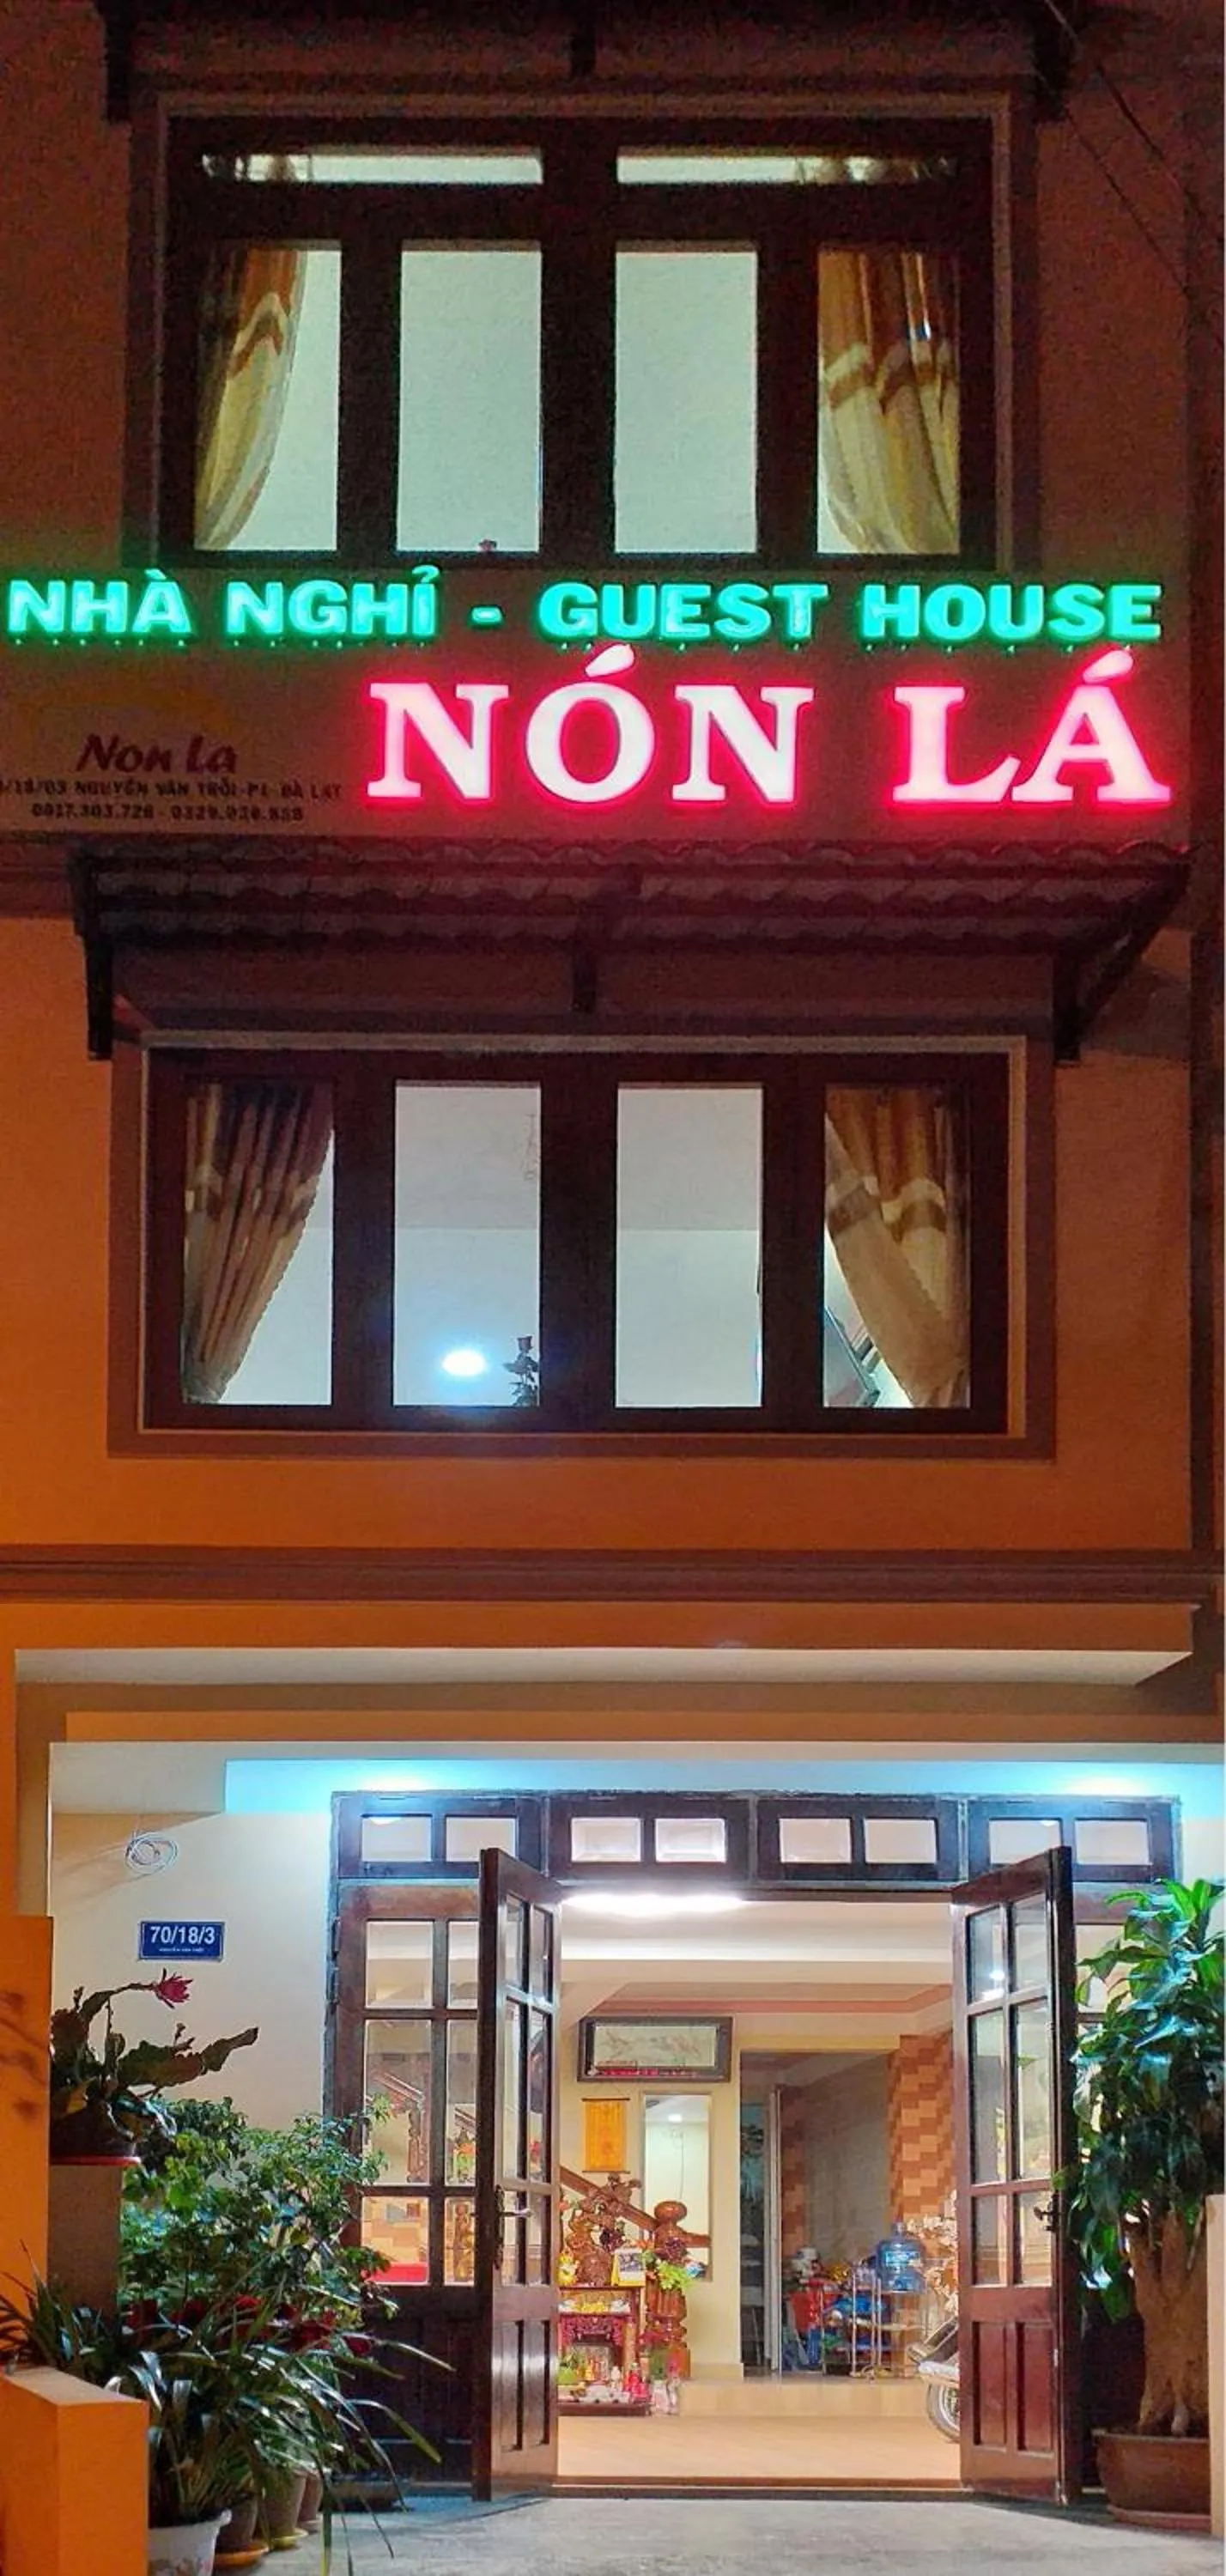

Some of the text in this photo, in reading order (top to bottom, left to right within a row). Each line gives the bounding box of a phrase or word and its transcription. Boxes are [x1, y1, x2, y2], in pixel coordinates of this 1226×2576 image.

[7, 568, 192, 635] NHÀ
[227, 564, 440, 637] NGHỈ
[538, 582, 828, 640] GUEST
[862, 584, 1162, 641] HOUSE
[76, 732, 173, 773] Non
[367, 643, 1171, 805] NÓN LÁ
[150, 1925, 215, 1945] 70/18/3
